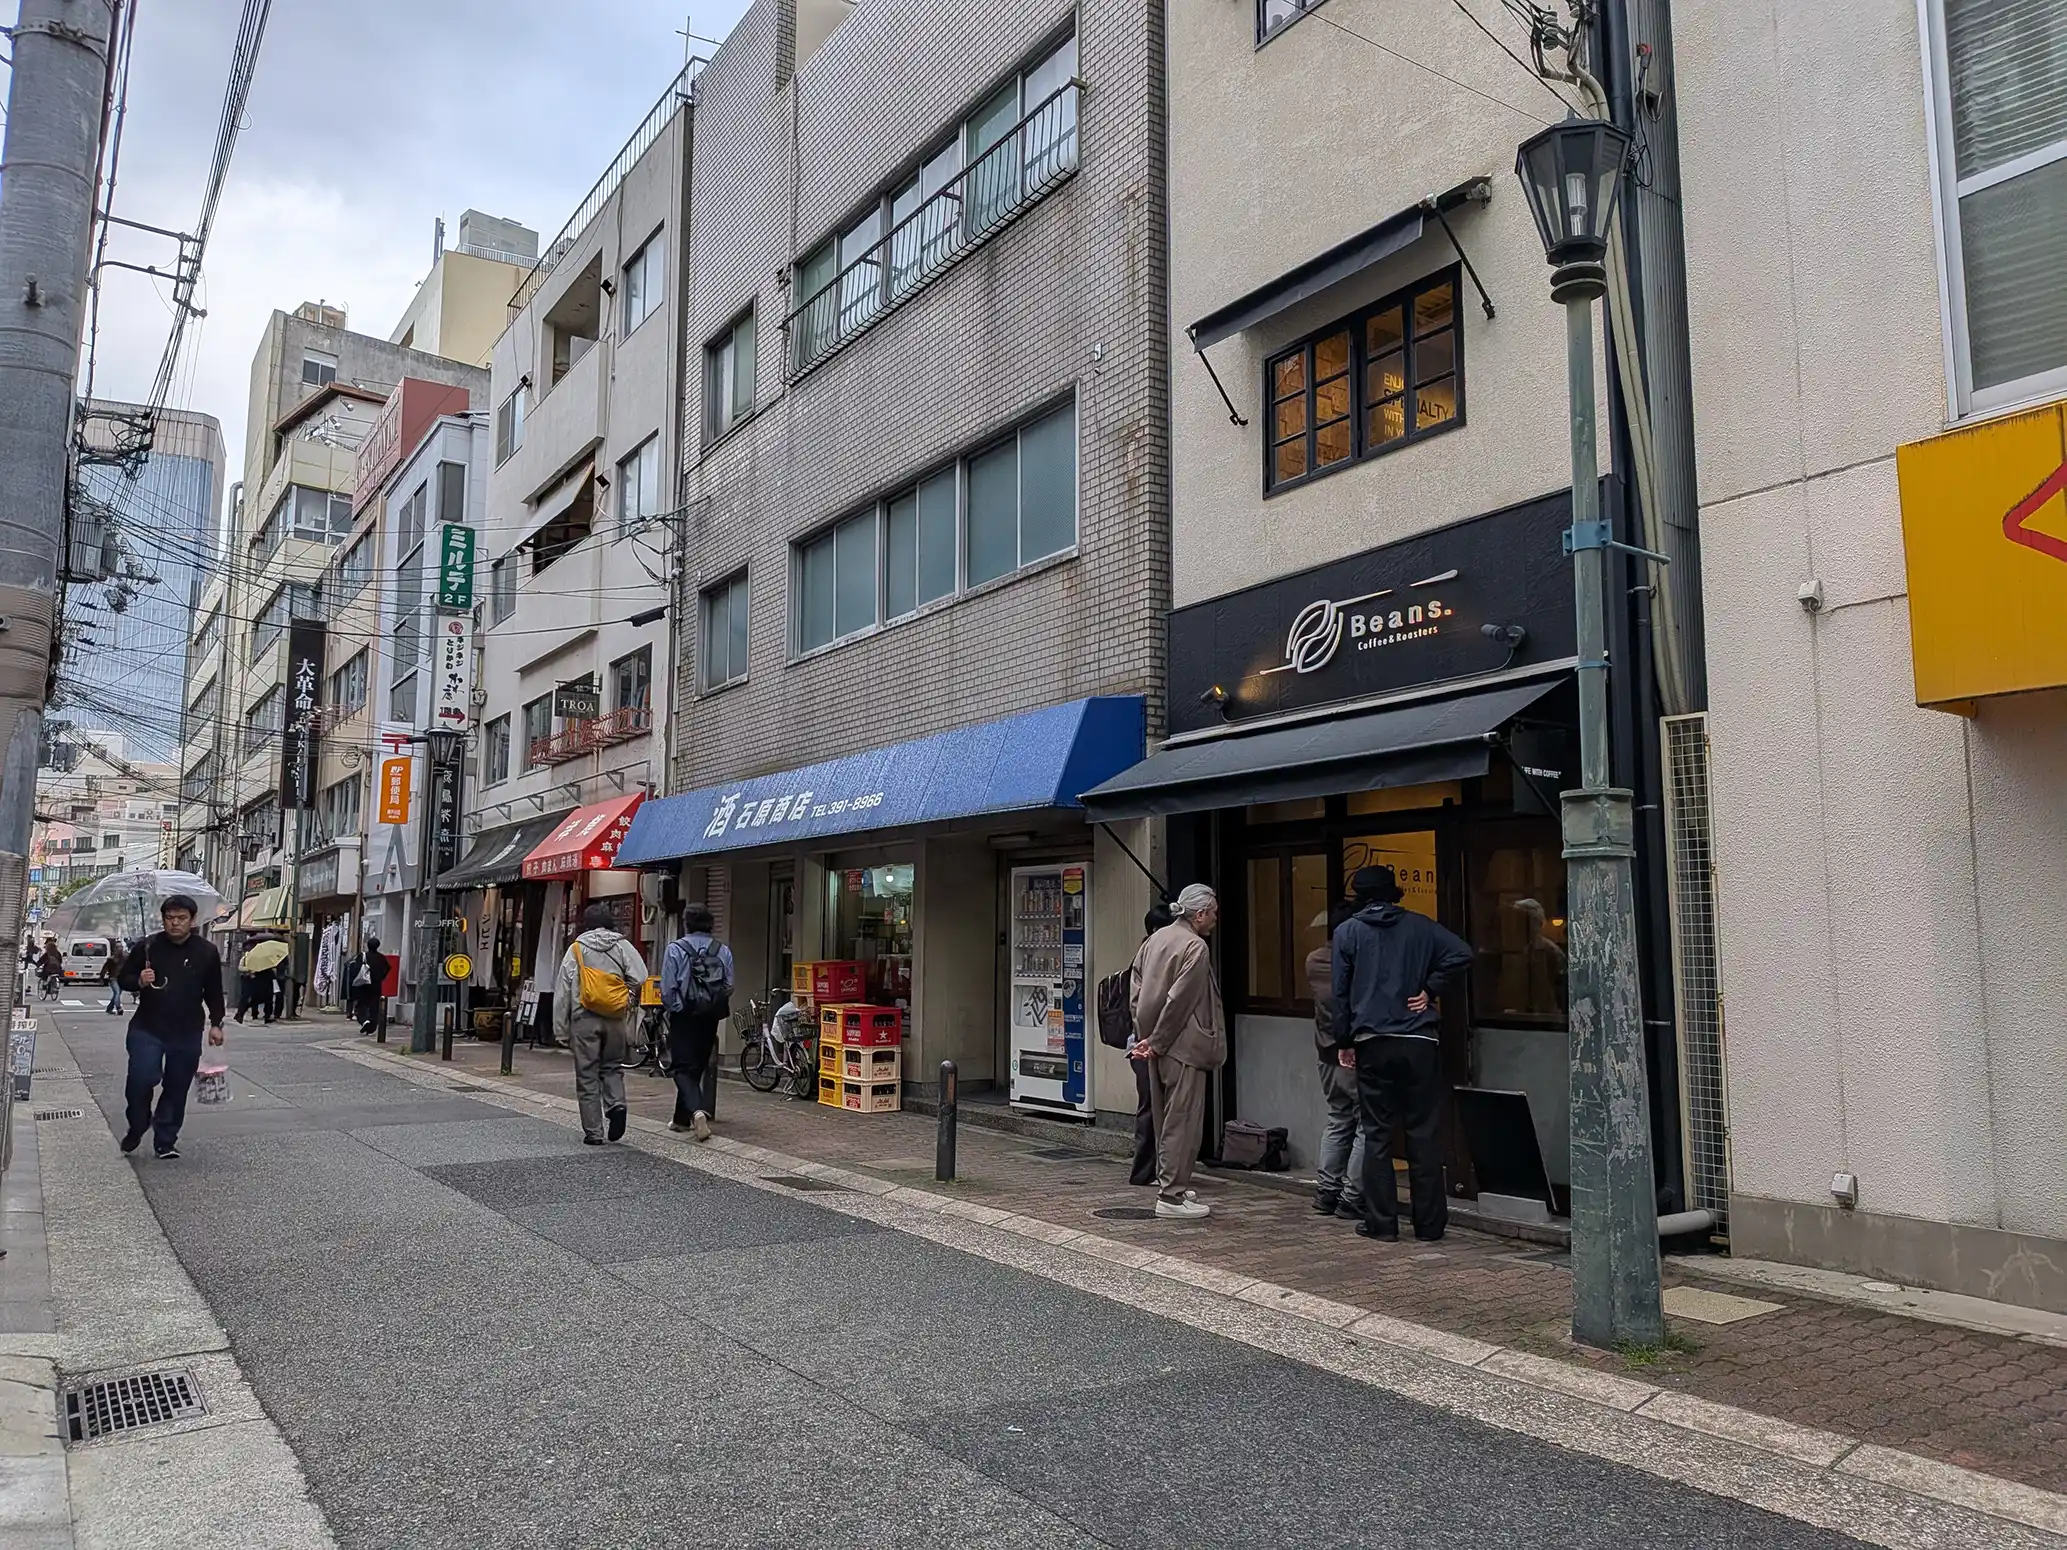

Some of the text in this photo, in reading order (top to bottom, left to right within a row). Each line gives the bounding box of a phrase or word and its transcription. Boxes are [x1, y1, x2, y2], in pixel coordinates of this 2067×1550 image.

[446, 528, 467, 591] ミルテ
[1351, 600, 1452, 638] Beans.
[294, 658, 316, 709] 大革命
[560, 699, 595, 712] TROA
[702, 791, 885, 840] 酒 石原商店 TEL 391-8966
